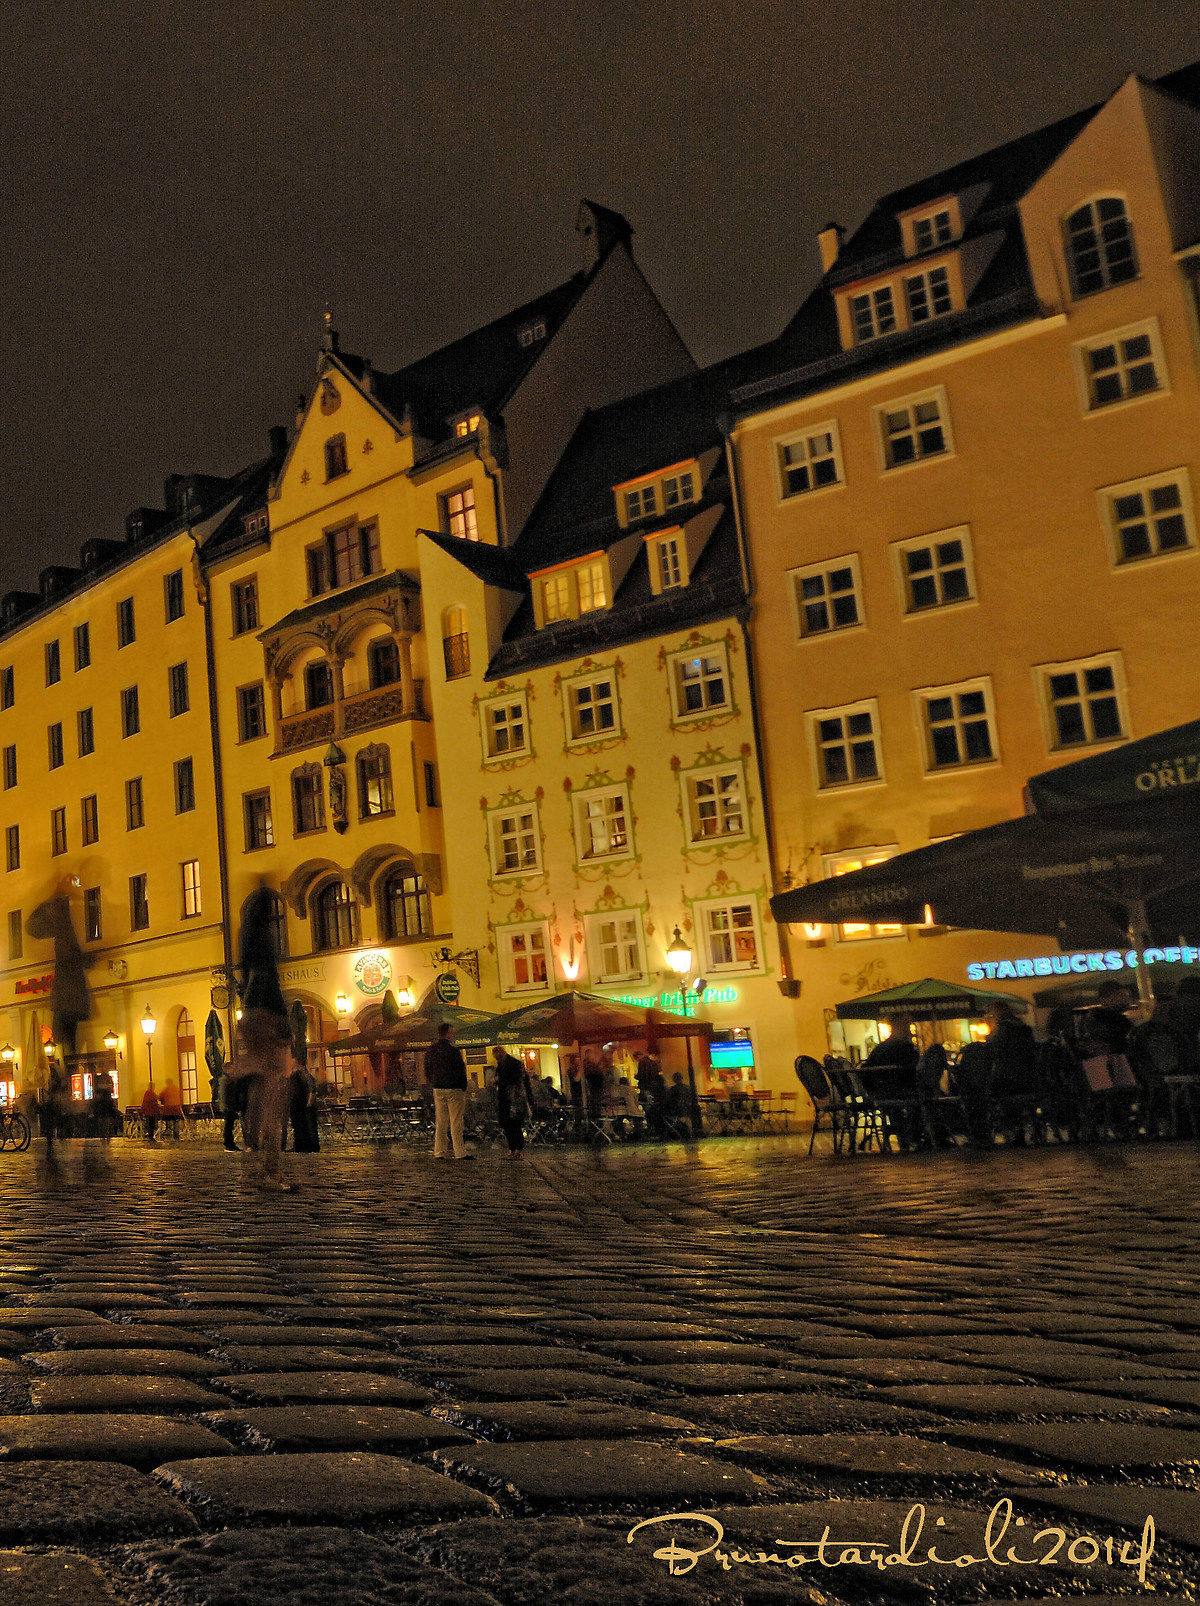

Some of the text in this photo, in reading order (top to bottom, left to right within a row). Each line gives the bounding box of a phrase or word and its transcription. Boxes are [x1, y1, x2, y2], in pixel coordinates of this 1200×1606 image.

[1135, 766, 1200, 791] ORL
[966, 950, 1124, 981] STARBUCKS
[704, 987, 738, 1004] Pub
